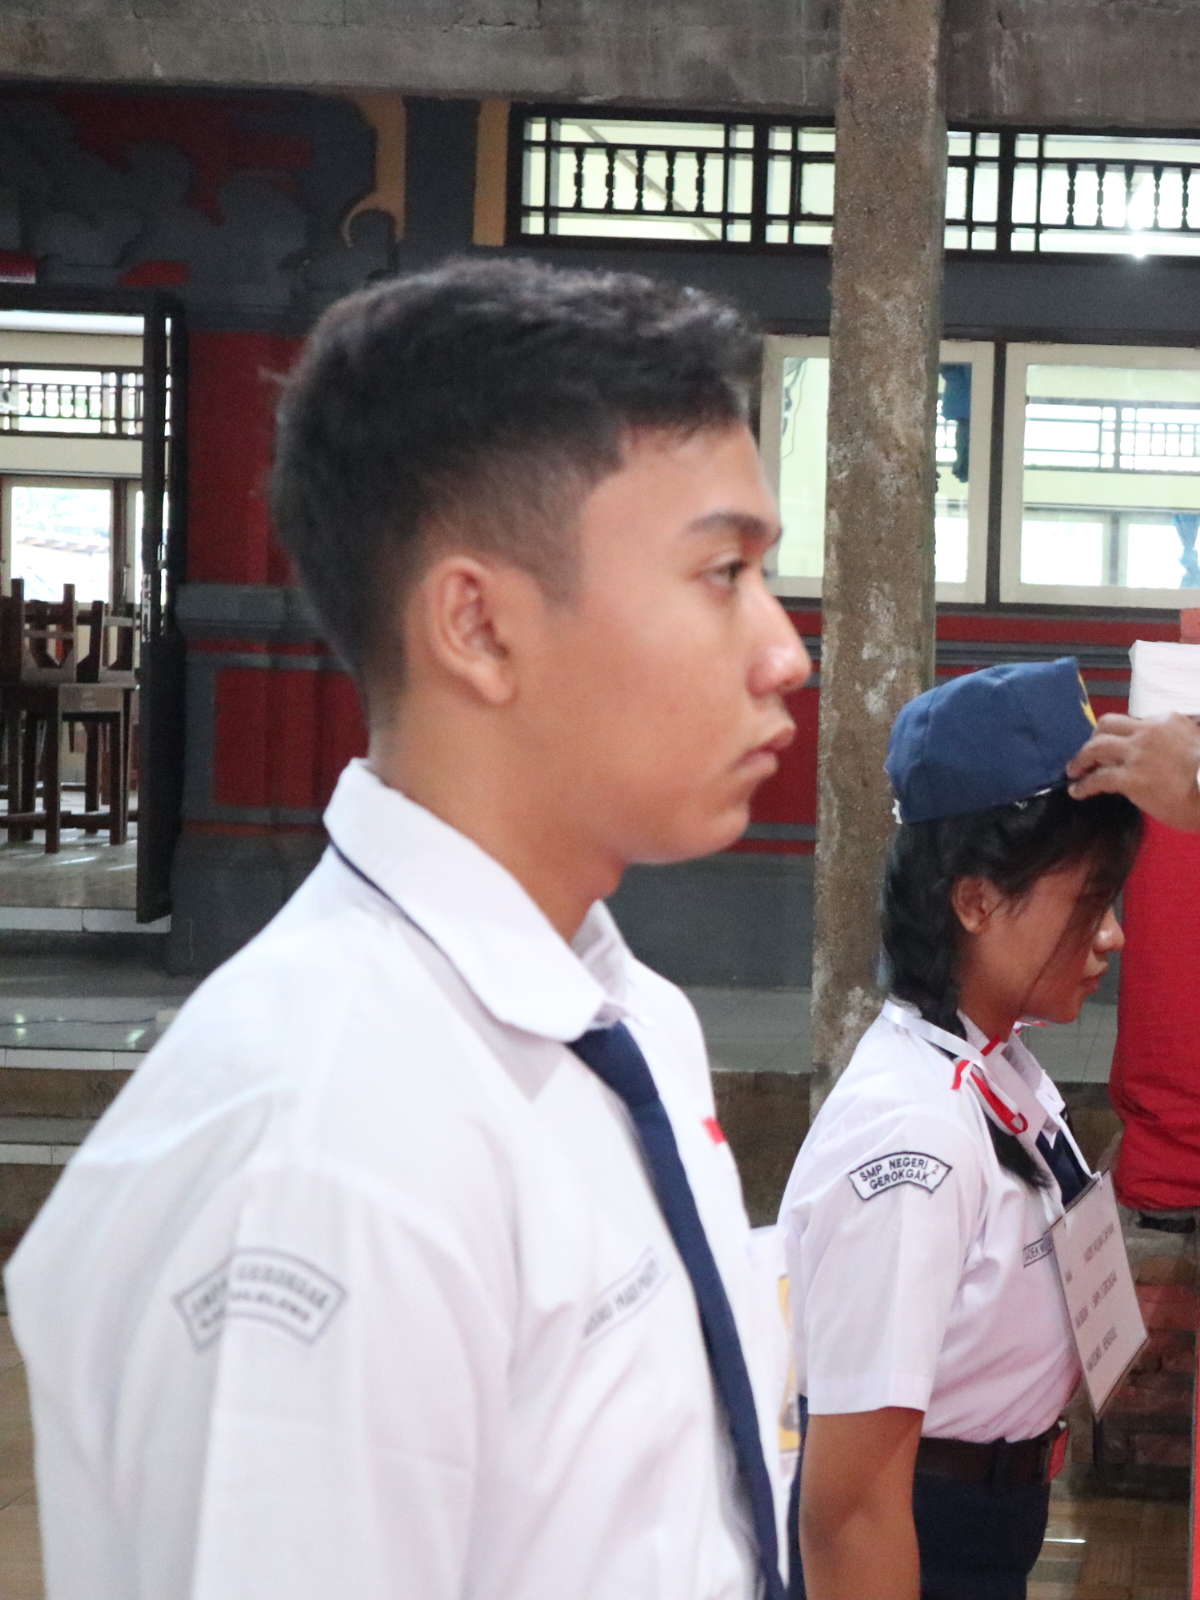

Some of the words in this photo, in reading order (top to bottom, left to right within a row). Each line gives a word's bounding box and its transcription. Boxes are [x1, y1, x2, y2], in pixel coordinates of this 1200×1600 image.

[860, 1164, 882, 1182] SMP
[889, 1158, 928, 1171] NEGERI
[931, 1164, 939, 1175] 2
[869, 1168, 930, 1190] GEROKGAK
